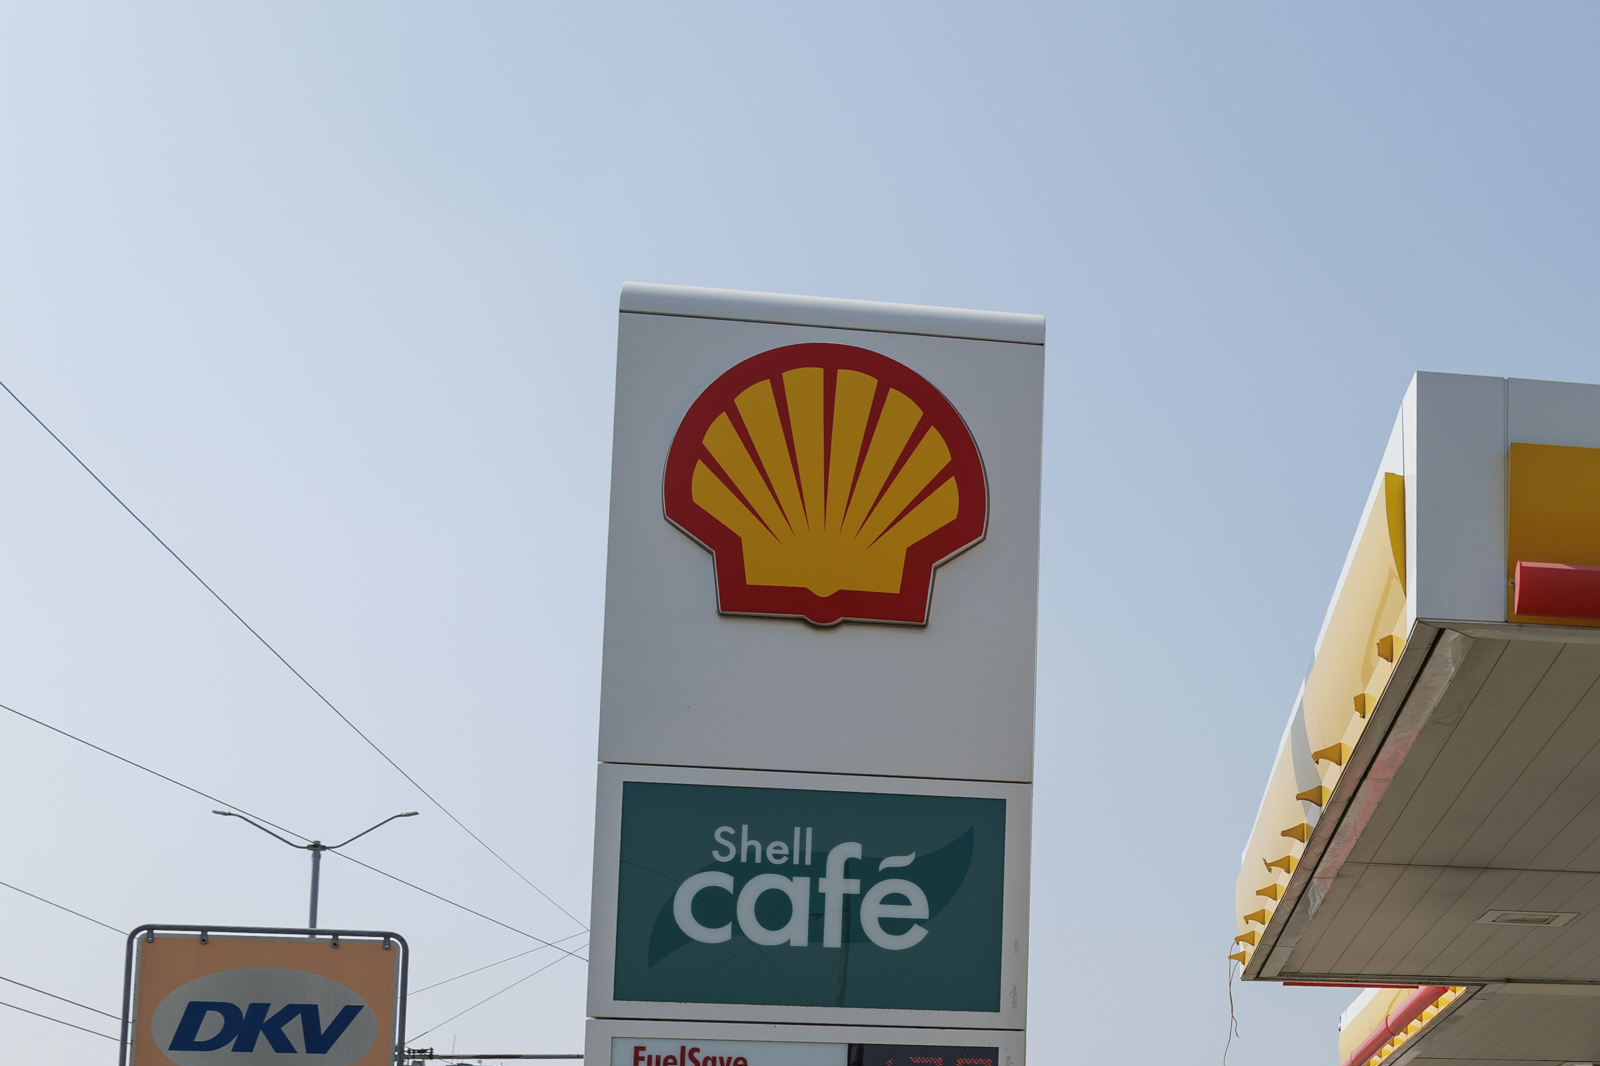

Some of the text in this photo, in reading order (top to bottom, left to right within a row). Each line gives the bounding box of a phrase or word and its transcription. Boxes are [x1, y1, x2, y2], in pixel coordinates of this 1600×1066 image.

[712, 825, 813, 866] Shell
[673, 841, 929, 951] café
[167, 1000, 365, 1055] DKV
